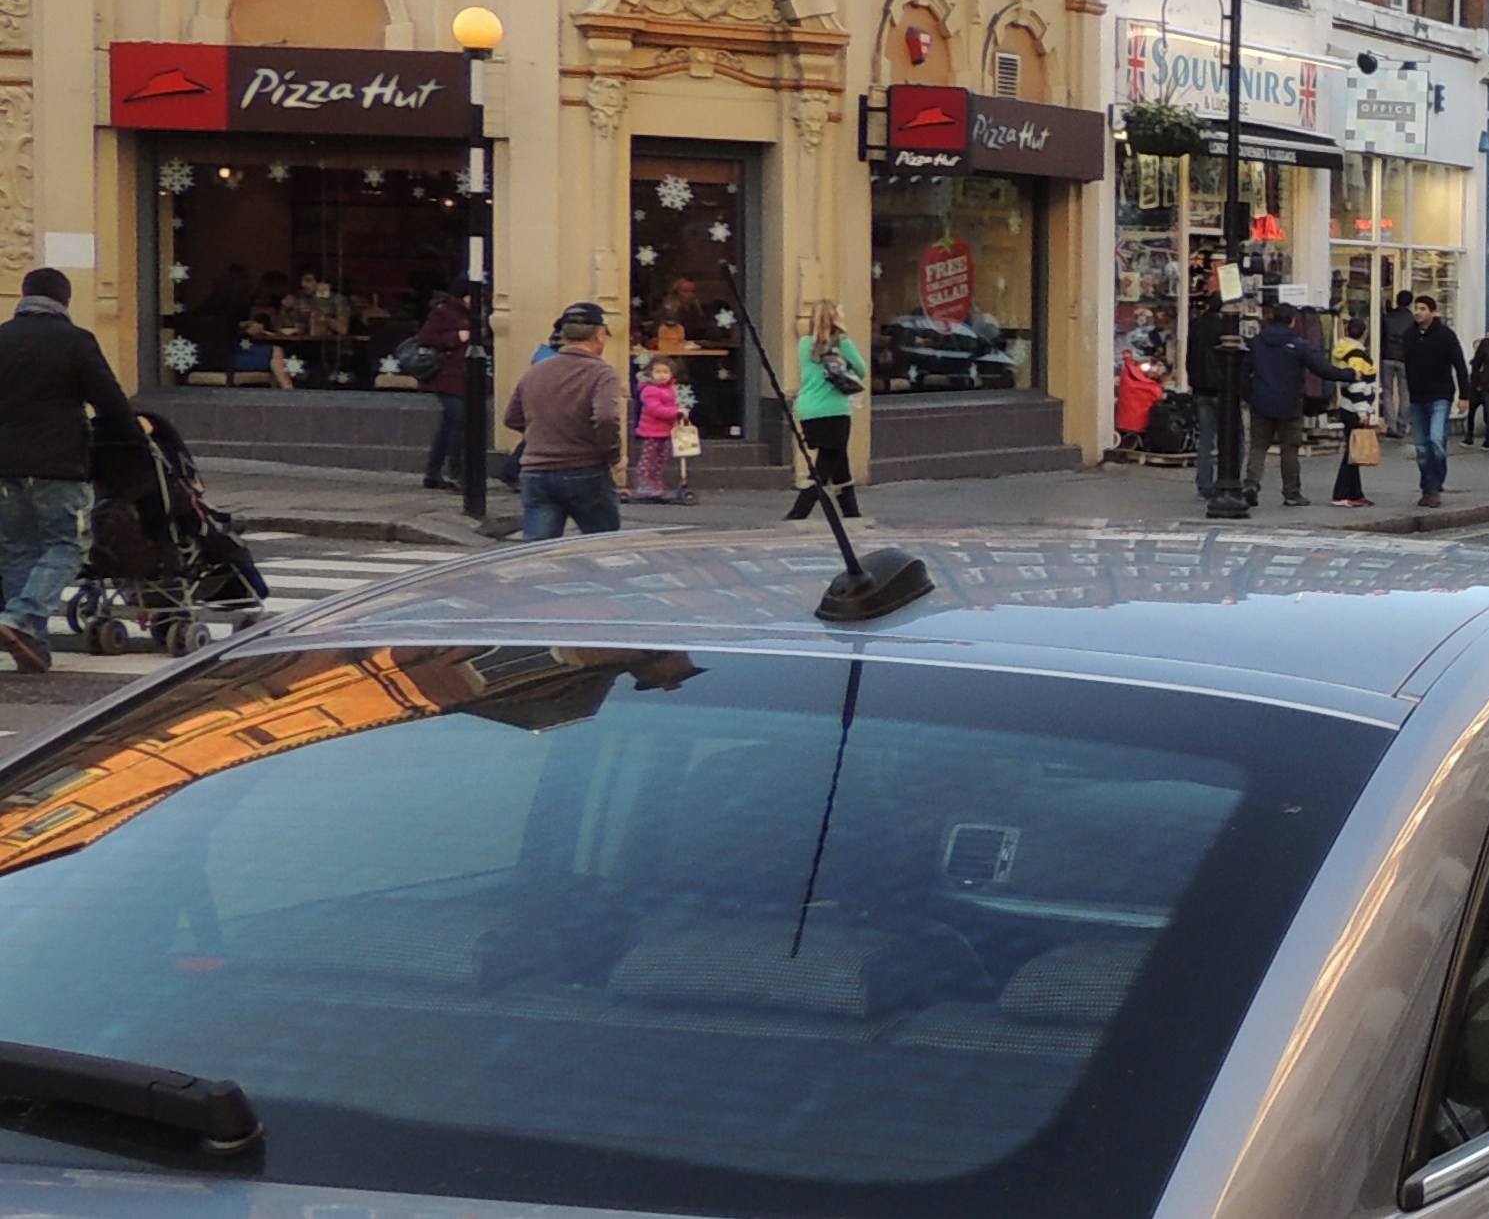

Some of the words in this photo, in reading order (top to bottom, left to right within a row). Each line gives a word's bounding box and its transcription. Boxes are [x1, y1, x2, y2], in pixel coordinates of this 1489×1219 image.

[240, 67, 355, 109] Pizza
[361, 72, 447, 109] Hut
[1361, 103, 1413, 114] OFFICE
[973, 113, 1018, 150] Pizza
[1019, 120, 1051, 152] Hut
[895, 150, 932, 167] Pizza
[933, 152, 962, 167] Hut
